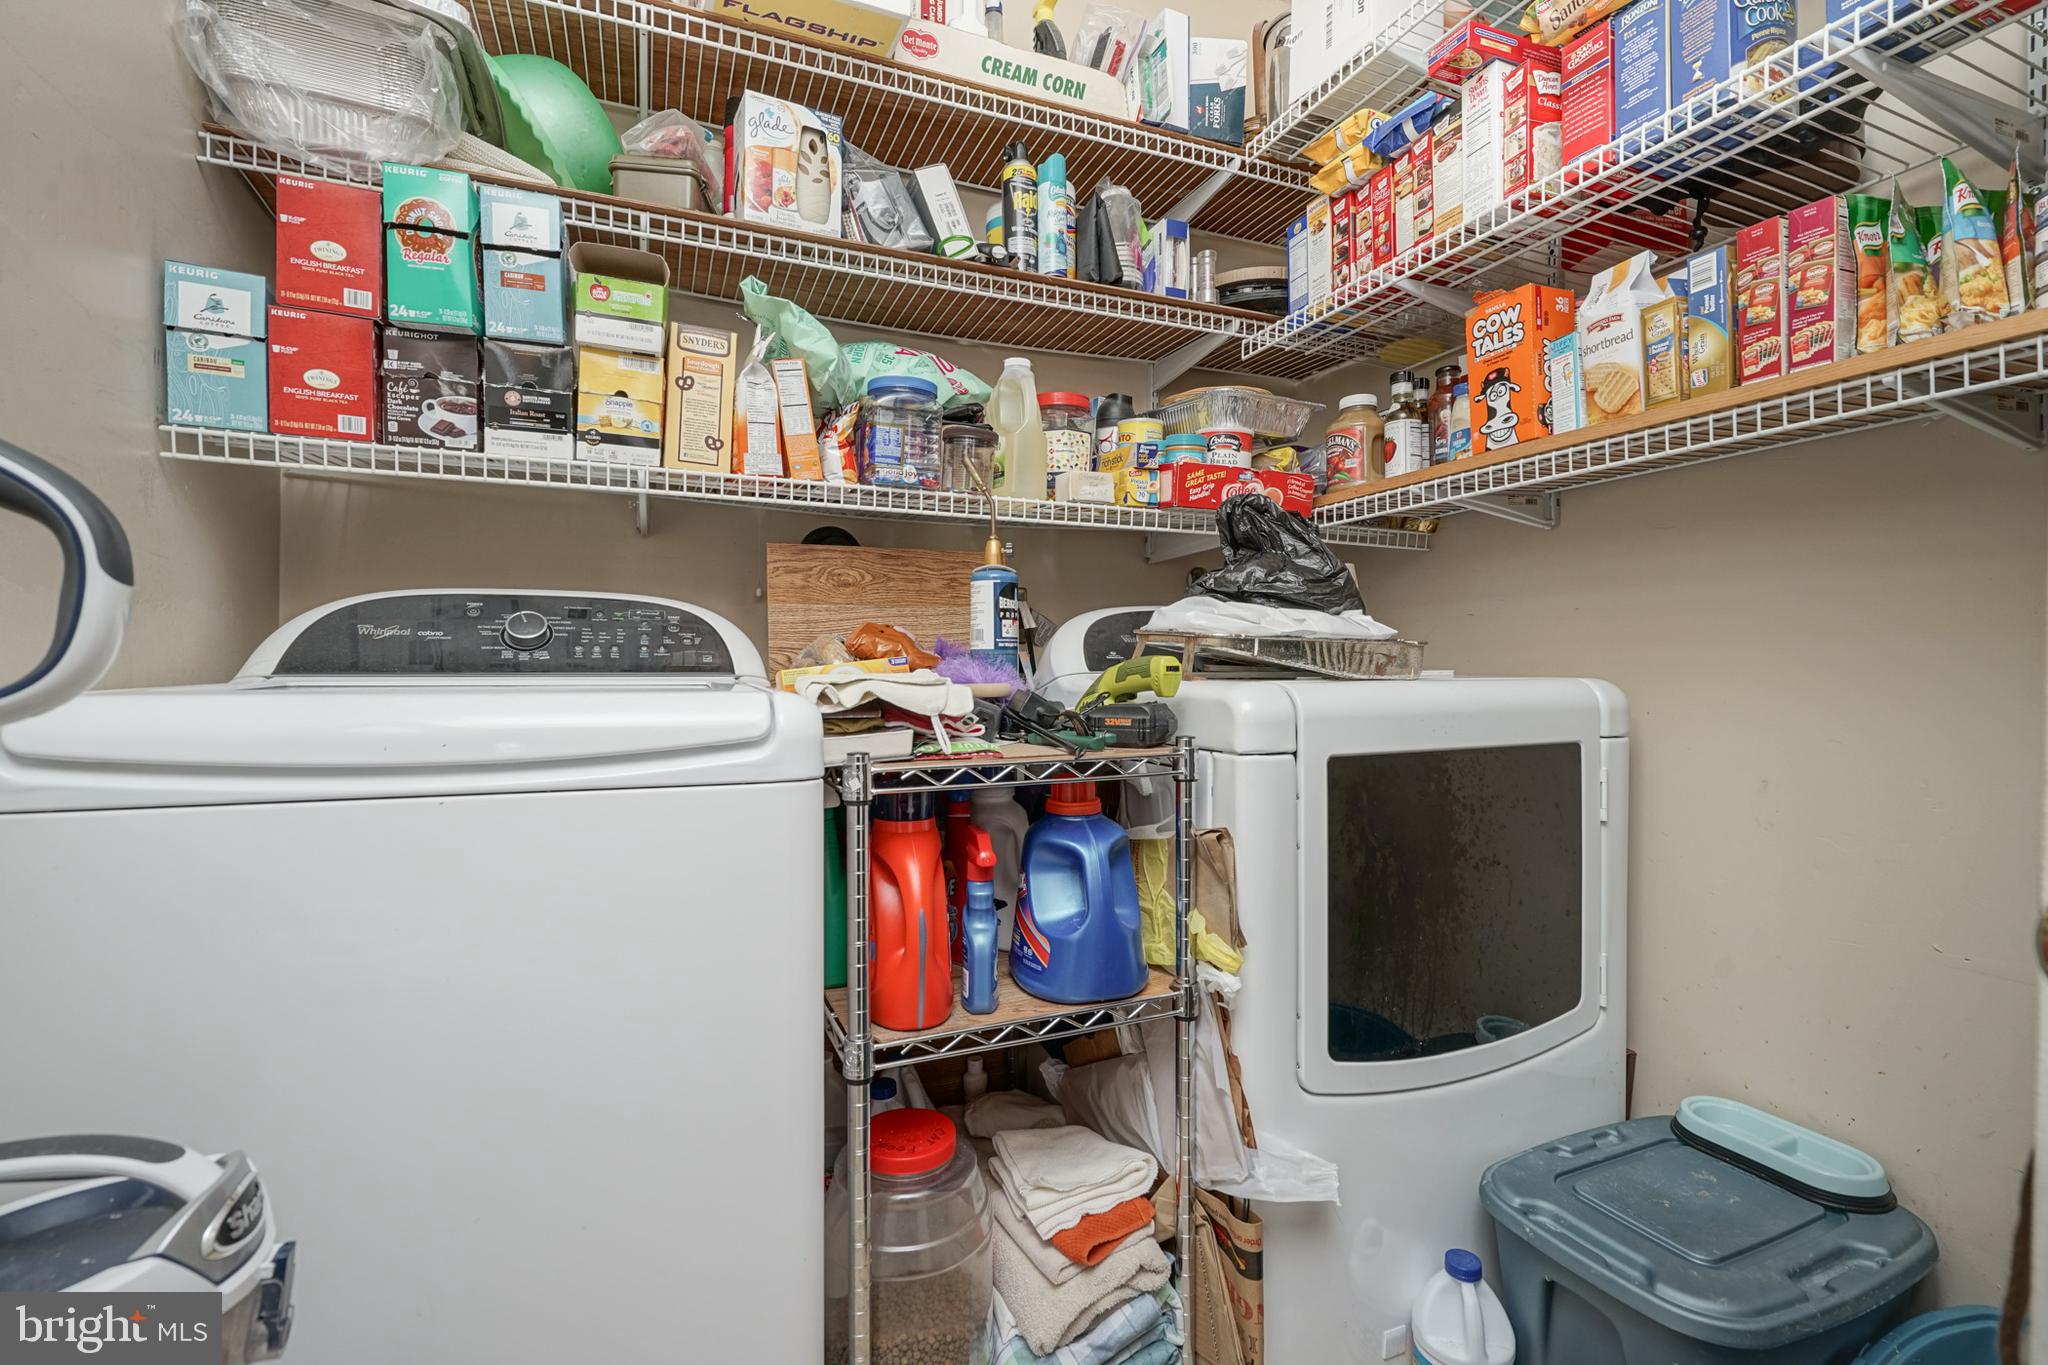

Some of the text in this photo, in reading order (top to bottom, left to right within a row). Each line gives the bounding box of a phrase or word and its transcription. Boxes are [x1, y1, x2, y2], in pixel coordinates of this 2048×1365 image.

[1745, 5, 1784, 26] Cook
[723, 1, 878, 47] FLAGSHIP
[903, 34, 937, 51] Del Monte
[1577, 41, 1594, 57] SAN
[1567, 41, 1604, 70] GIORGIO
[981, 55, 1087, 100] CREAM CORN
[1213, 96, 1221, 128] FORKS
[748, 111, 794, 138] glade
[827, 132, 840, 143] 60
[384, 165, 427, 177] KEURIG
[279, 177, 315, 189] KEURIG
[1855, 229, 1881, 243] Knorr
[401, 247, 451, 265] Regular
[168, 264, 219, 280] KEURIG
[290, 257, 365, 275] ENGLISH BREAKFAST
[389, 303, 409, 318] 24
[1485, 302, 1507, 314] VANILLA
[1555, 296, 1564, 312] 36
[271, 309, 307, 319] KEURIG
[1472, 303, 1521, 338] COW
[385, 329, 420, 339] KEURIG
[488, 321, 505, 333] 24
[682, 334, 726, 350] SNYDER'S
[1472, 322, 1524, 358] TALES
[1582, 328, 1634, 358] shortbread
[881, 354, 895, 366] 35
[283, 386, 358, 401] ENGLISH BREAKFAST
[386, 382, 408, 395] Café
[387, 392, 420, 400] Escapes
[172, 407, 194, 422] 24
[387, 404, 419, 412] Chocolate
[509, 409, 529, 417] Italian
[1209, 435, 1240, 446] Colonna
[1209, 458, 1239, 466] BREAD
[1185, 470, 1227, 488] GREAT TASTE!
[1186, 469, 1205, 481] SAME
[1189, 482, 1215, 495] Easy Grip
[1189, 490, 1211, 501] Handle!
[357, 624, 411, 640] Whirlpool
